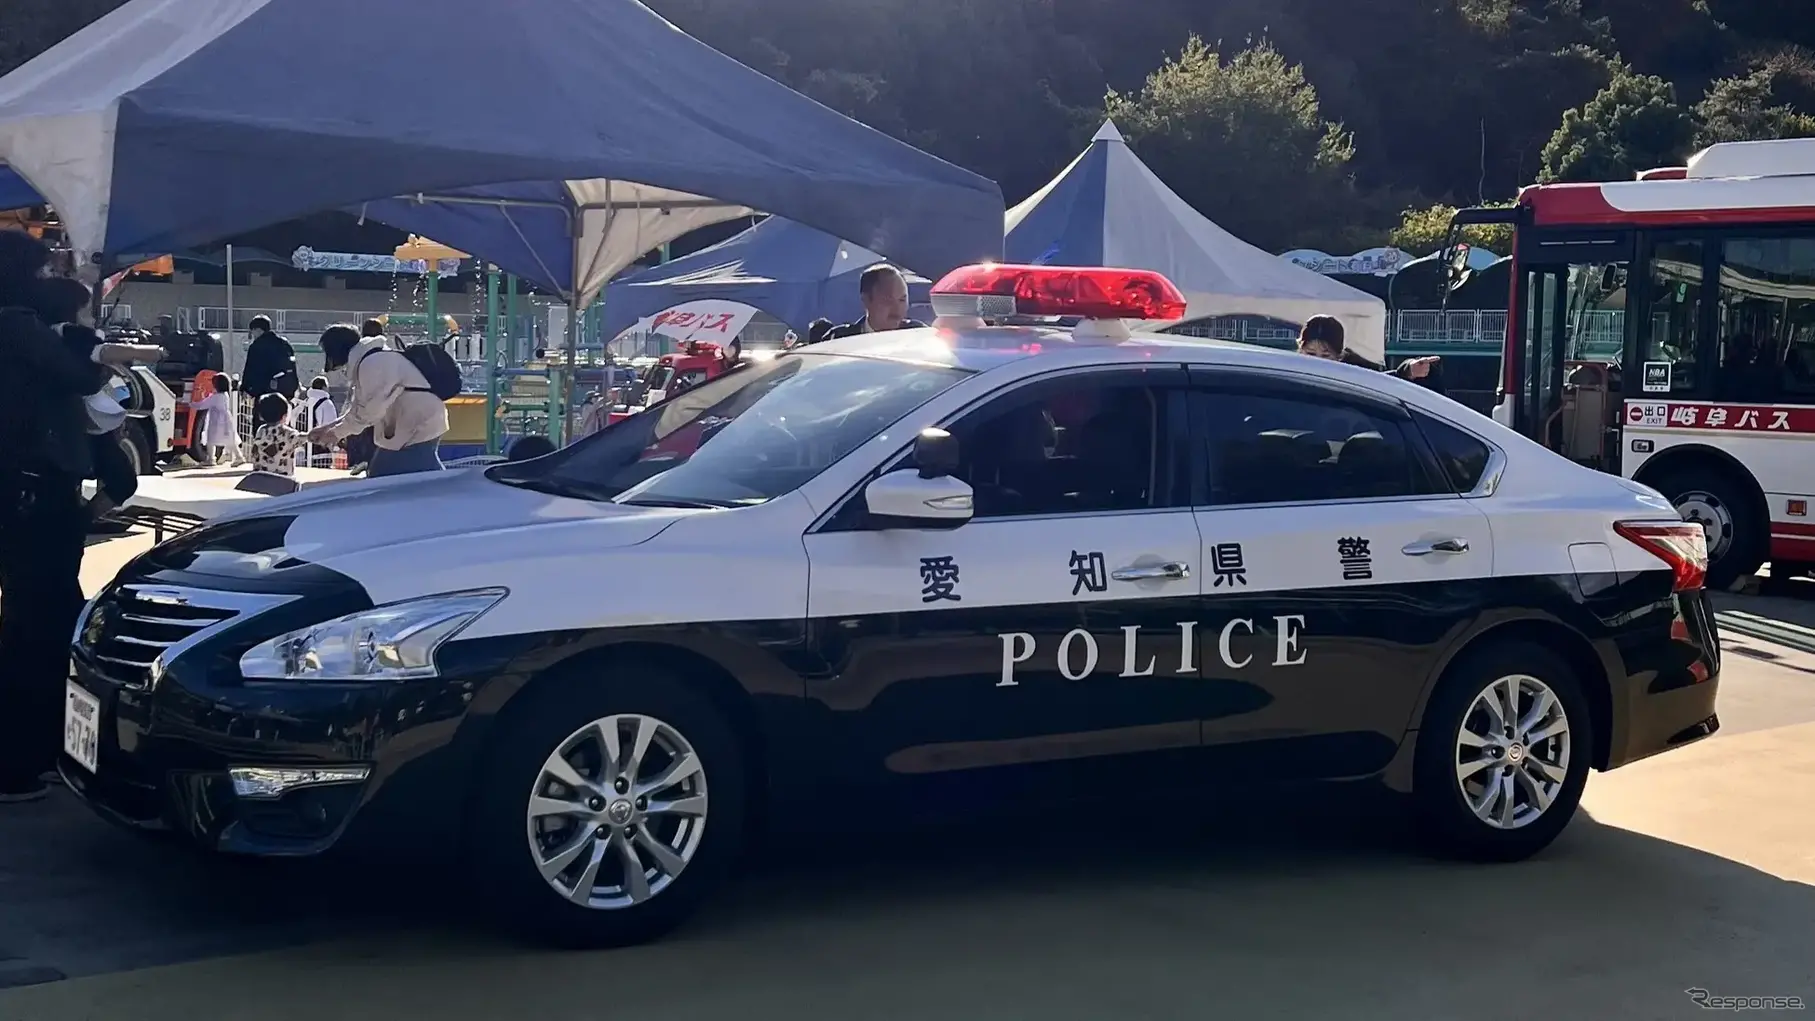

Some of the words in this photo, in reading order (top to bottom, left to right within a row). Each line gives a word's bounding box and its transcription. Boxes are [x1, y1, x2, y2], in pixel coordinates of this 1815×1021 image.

[160, 407, 171, 421] 38
[1644, 406, 1666, 417] 出口
[1646, 417, 1662, 425] EXIT
[1671, 406, 1790, 430] 岐阜バス
[919, 536, 1374, 603] 愛知県警
[996, 613, 1308, 687] POLICE
